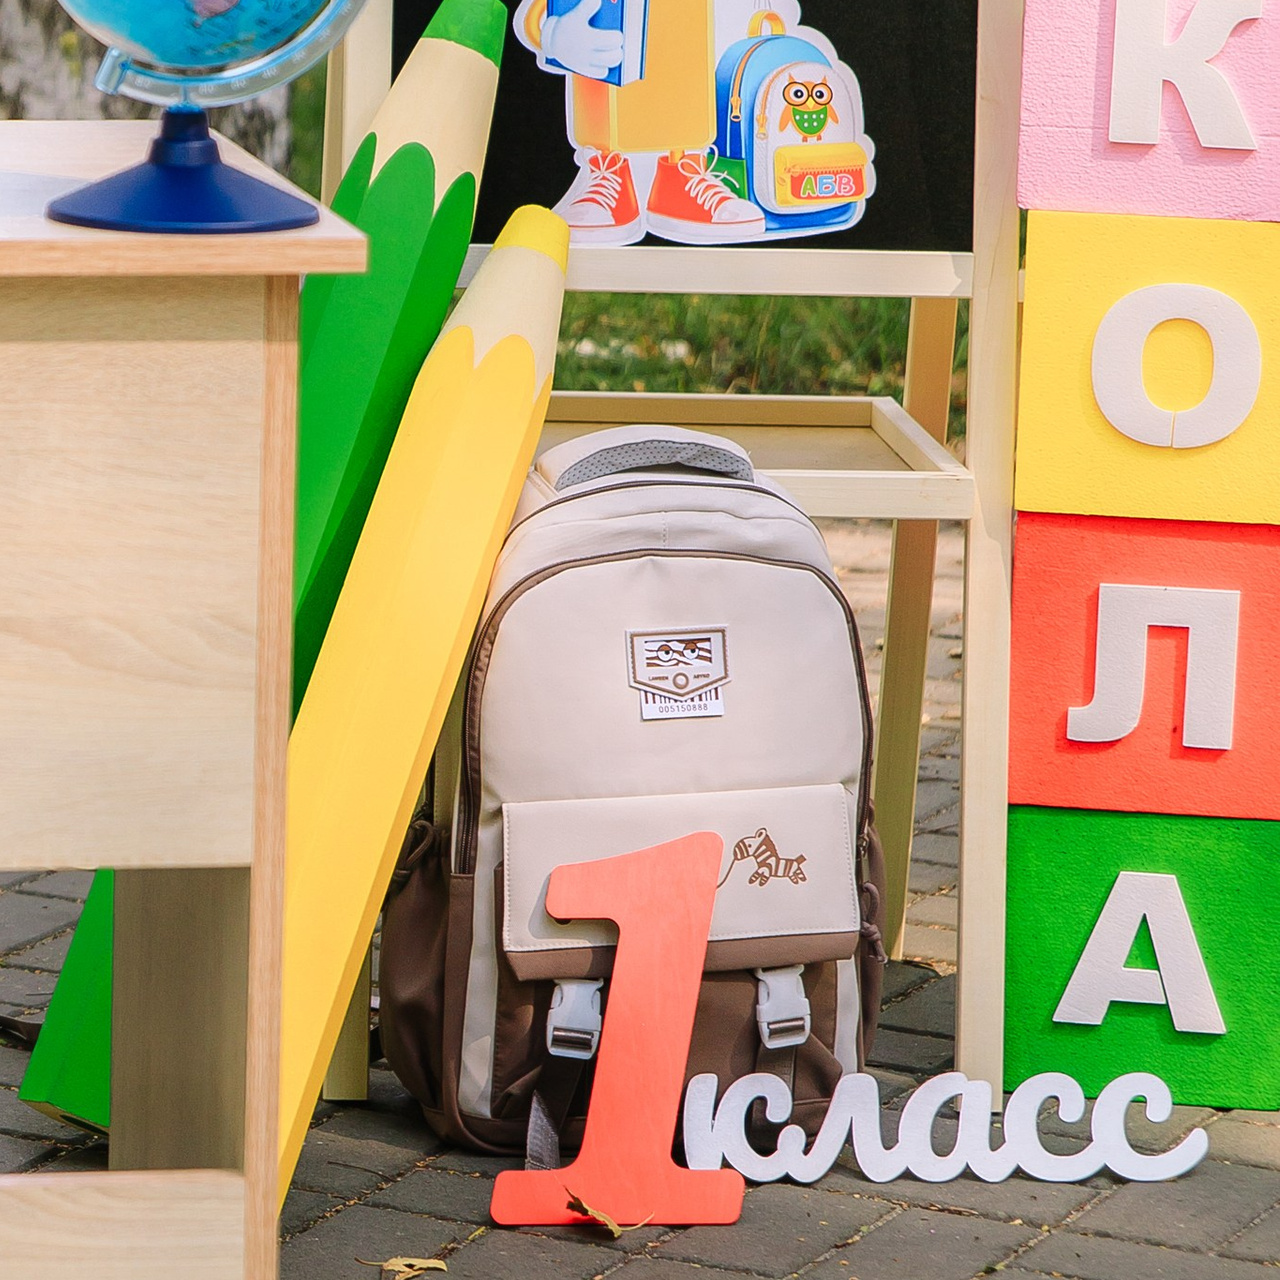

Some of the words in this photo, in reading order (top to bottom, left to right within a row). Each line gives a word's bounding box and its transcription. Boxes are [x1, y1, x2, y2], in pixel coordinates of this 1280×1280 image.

[801, 174, 855, 197] АБВ
[658, 703, 709, 714] 005150888
[490, 831, 745, 1225] 1
[683, 1072, 1209, 1183] класс
